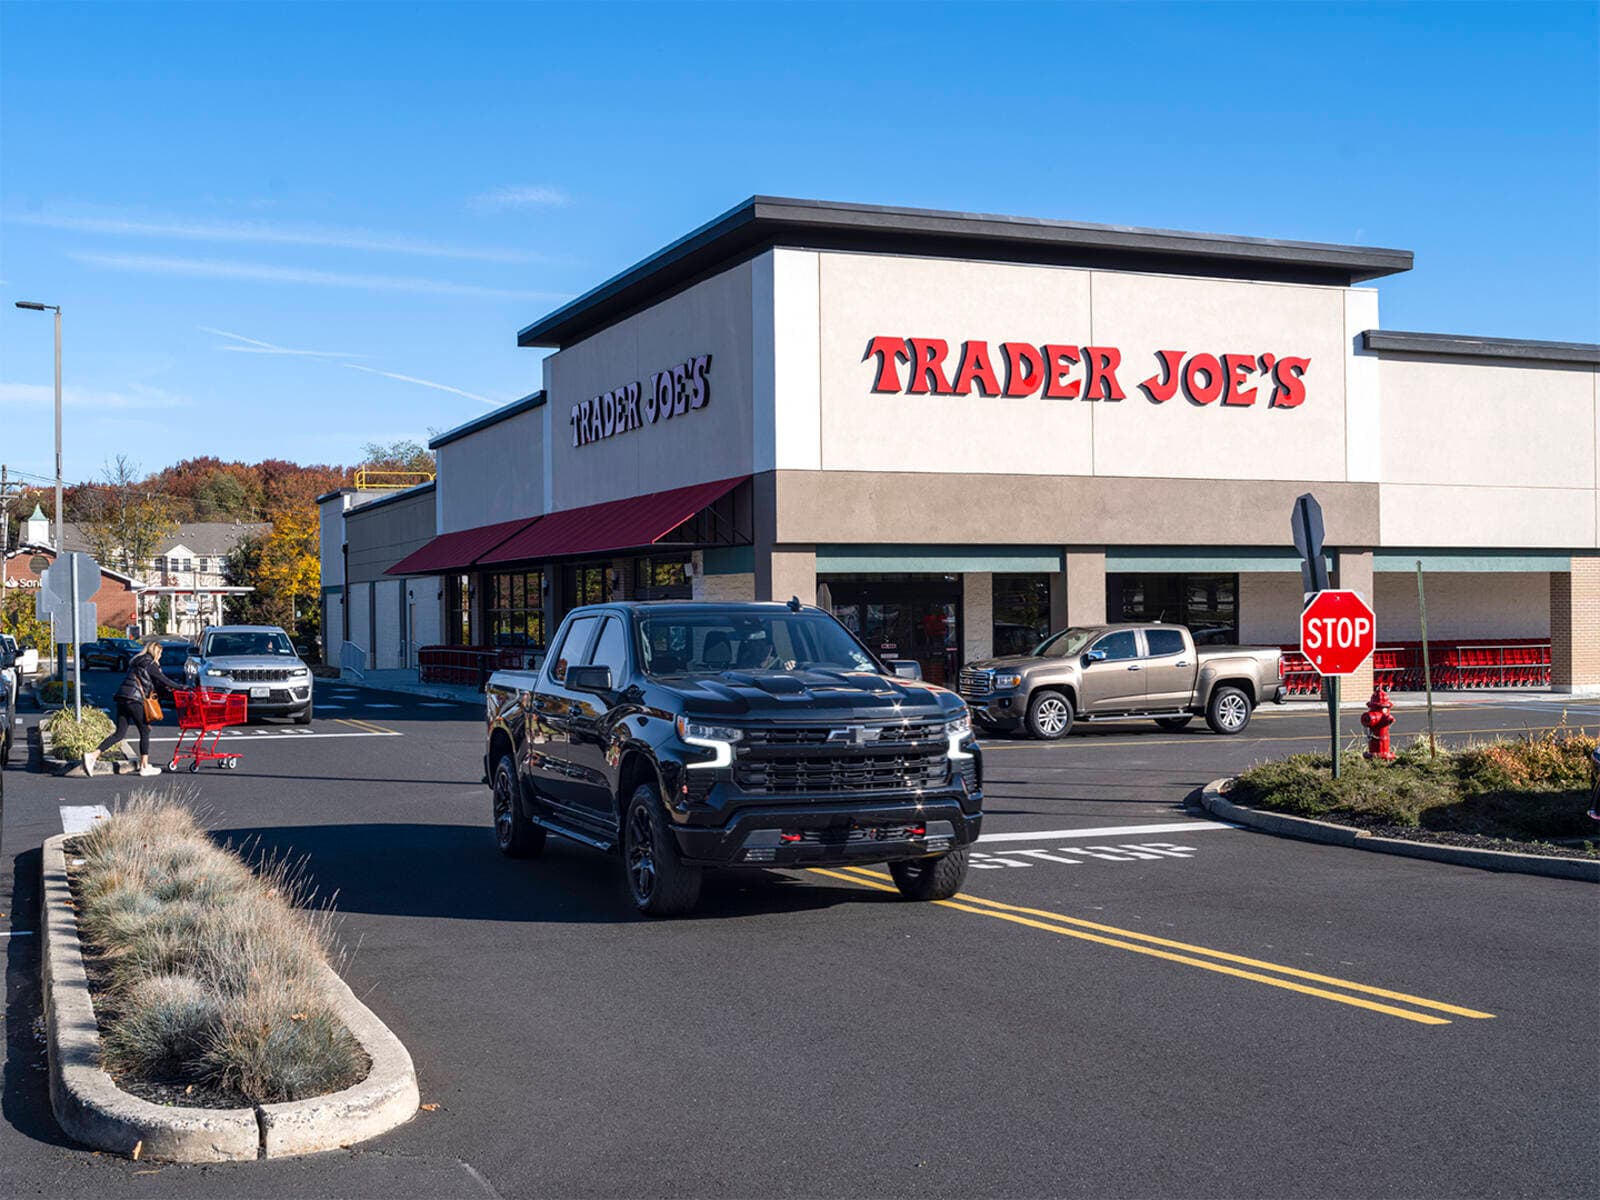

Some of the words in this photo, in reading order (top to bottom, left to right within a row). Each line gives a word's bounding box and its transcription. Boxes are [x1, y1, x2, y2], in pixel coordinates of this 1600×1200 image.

[570, 381, 643, 447] TRADER
[645, 354, 712, 423] JOE'S
[861, 336, 1126, 401] TRADER
[1137, 350, 1311, 410] JOE'S
[1306, 617, 1370, 648] STOP
